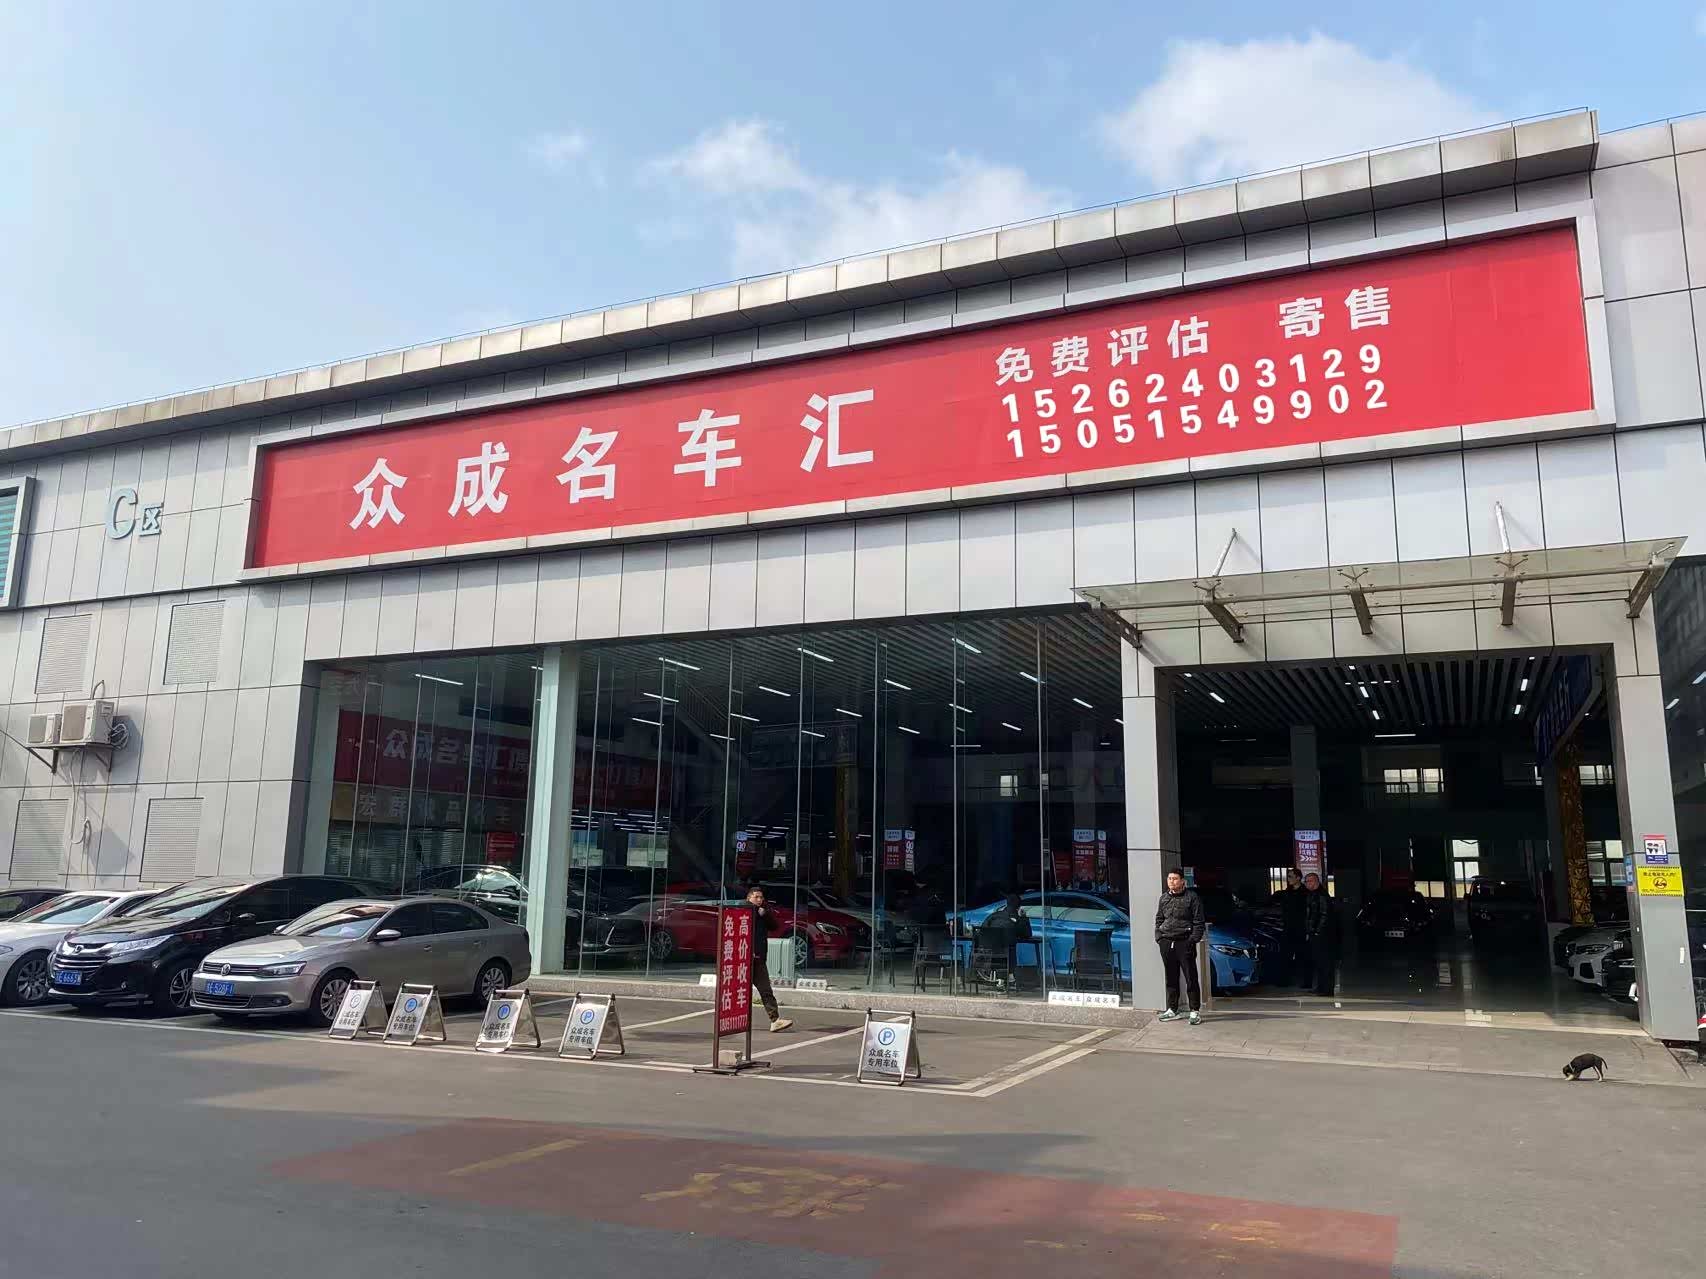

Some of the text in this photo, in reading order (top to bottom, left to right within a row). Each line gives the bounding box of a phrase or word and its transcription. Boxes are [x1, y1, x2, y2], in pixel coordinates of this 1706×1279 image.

[995, 285, 1391, 387] 免费评估 寄售
[1002, 343, 1382, 423] 15262403129
[1006, 380, 1387, 458] 15051549902
[349, 389, 875, 529] 众成名车汇
[105, 486, 164, 541] C区
[721, 915, 735, 1012] 免费评估
[737, 914, 750, 1009] 高价收车
[393, 1022, 416, 1031] 专用车位
[569, 1035, 592, 1045] 专用车位
[571, 1027, 595, 1036] 众成名车
[869, 1048, 901, 1058] 众成名车
[868, 1058, 898, 1068] 专用车位
